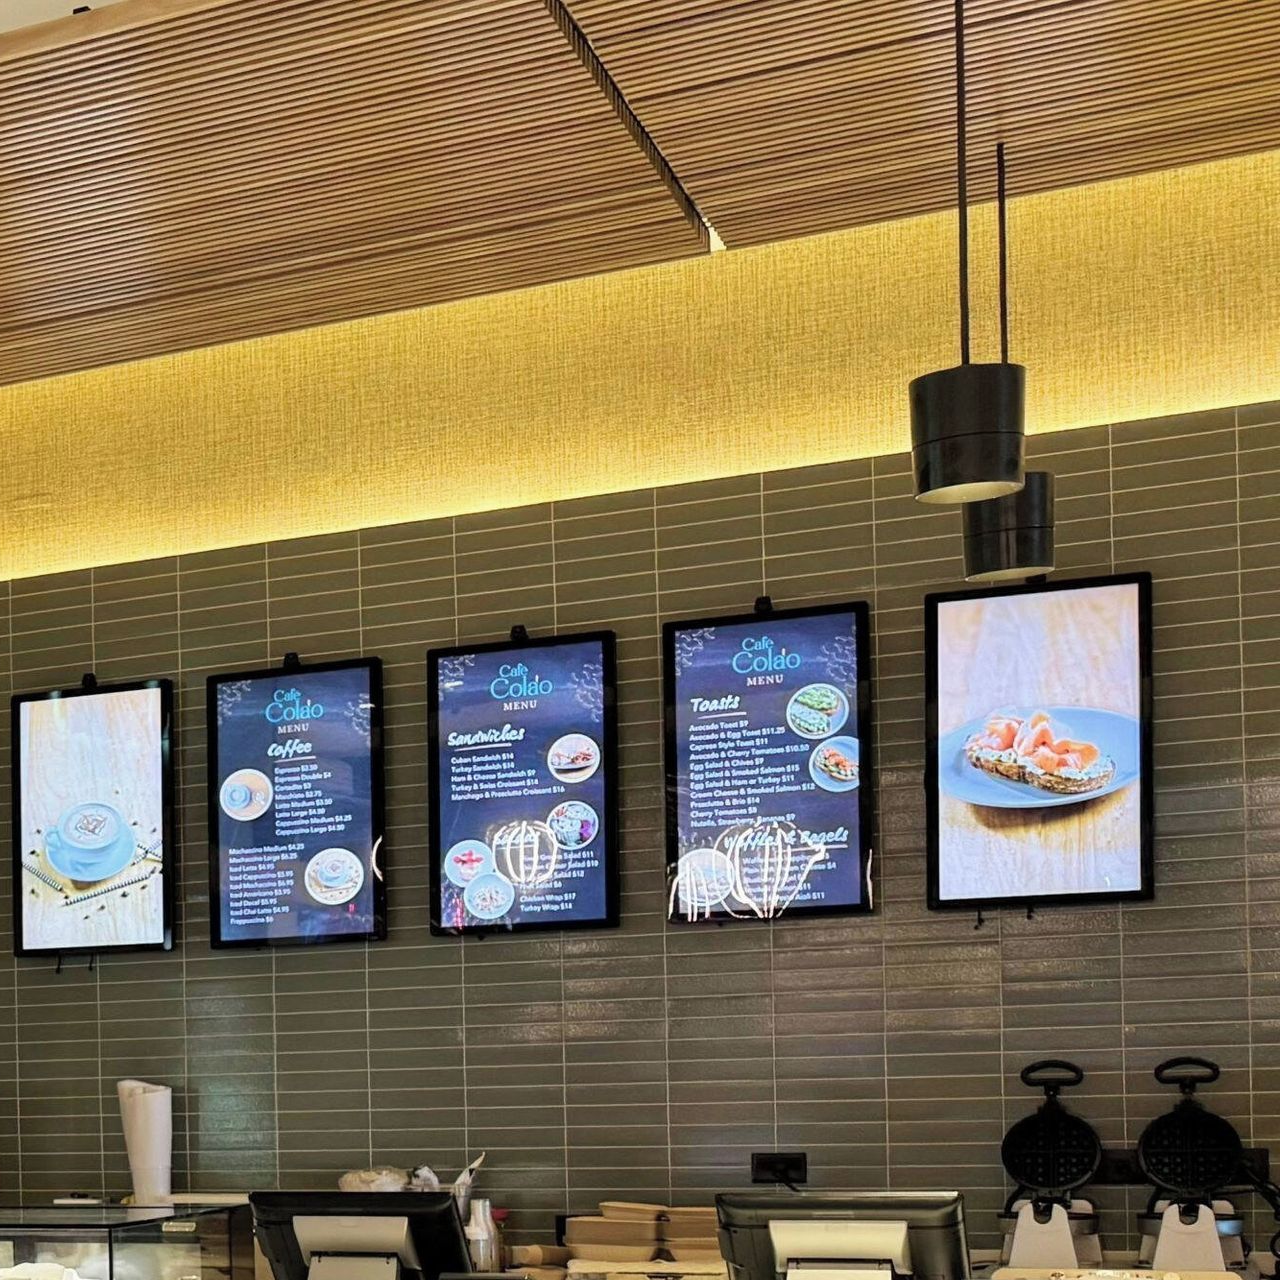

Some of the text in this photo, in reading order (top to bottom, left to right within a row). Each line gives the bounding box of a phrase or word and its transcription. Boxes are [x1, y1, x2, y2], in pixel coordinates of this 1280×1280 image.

[746, 674, 784, 686] MENU
[503, 700, 537, 711] MENU
[690, 695, 740, 712] Toasts
[278, 723, 309, 734] MENU
[448, 724, 525, 746] Sandwiches
